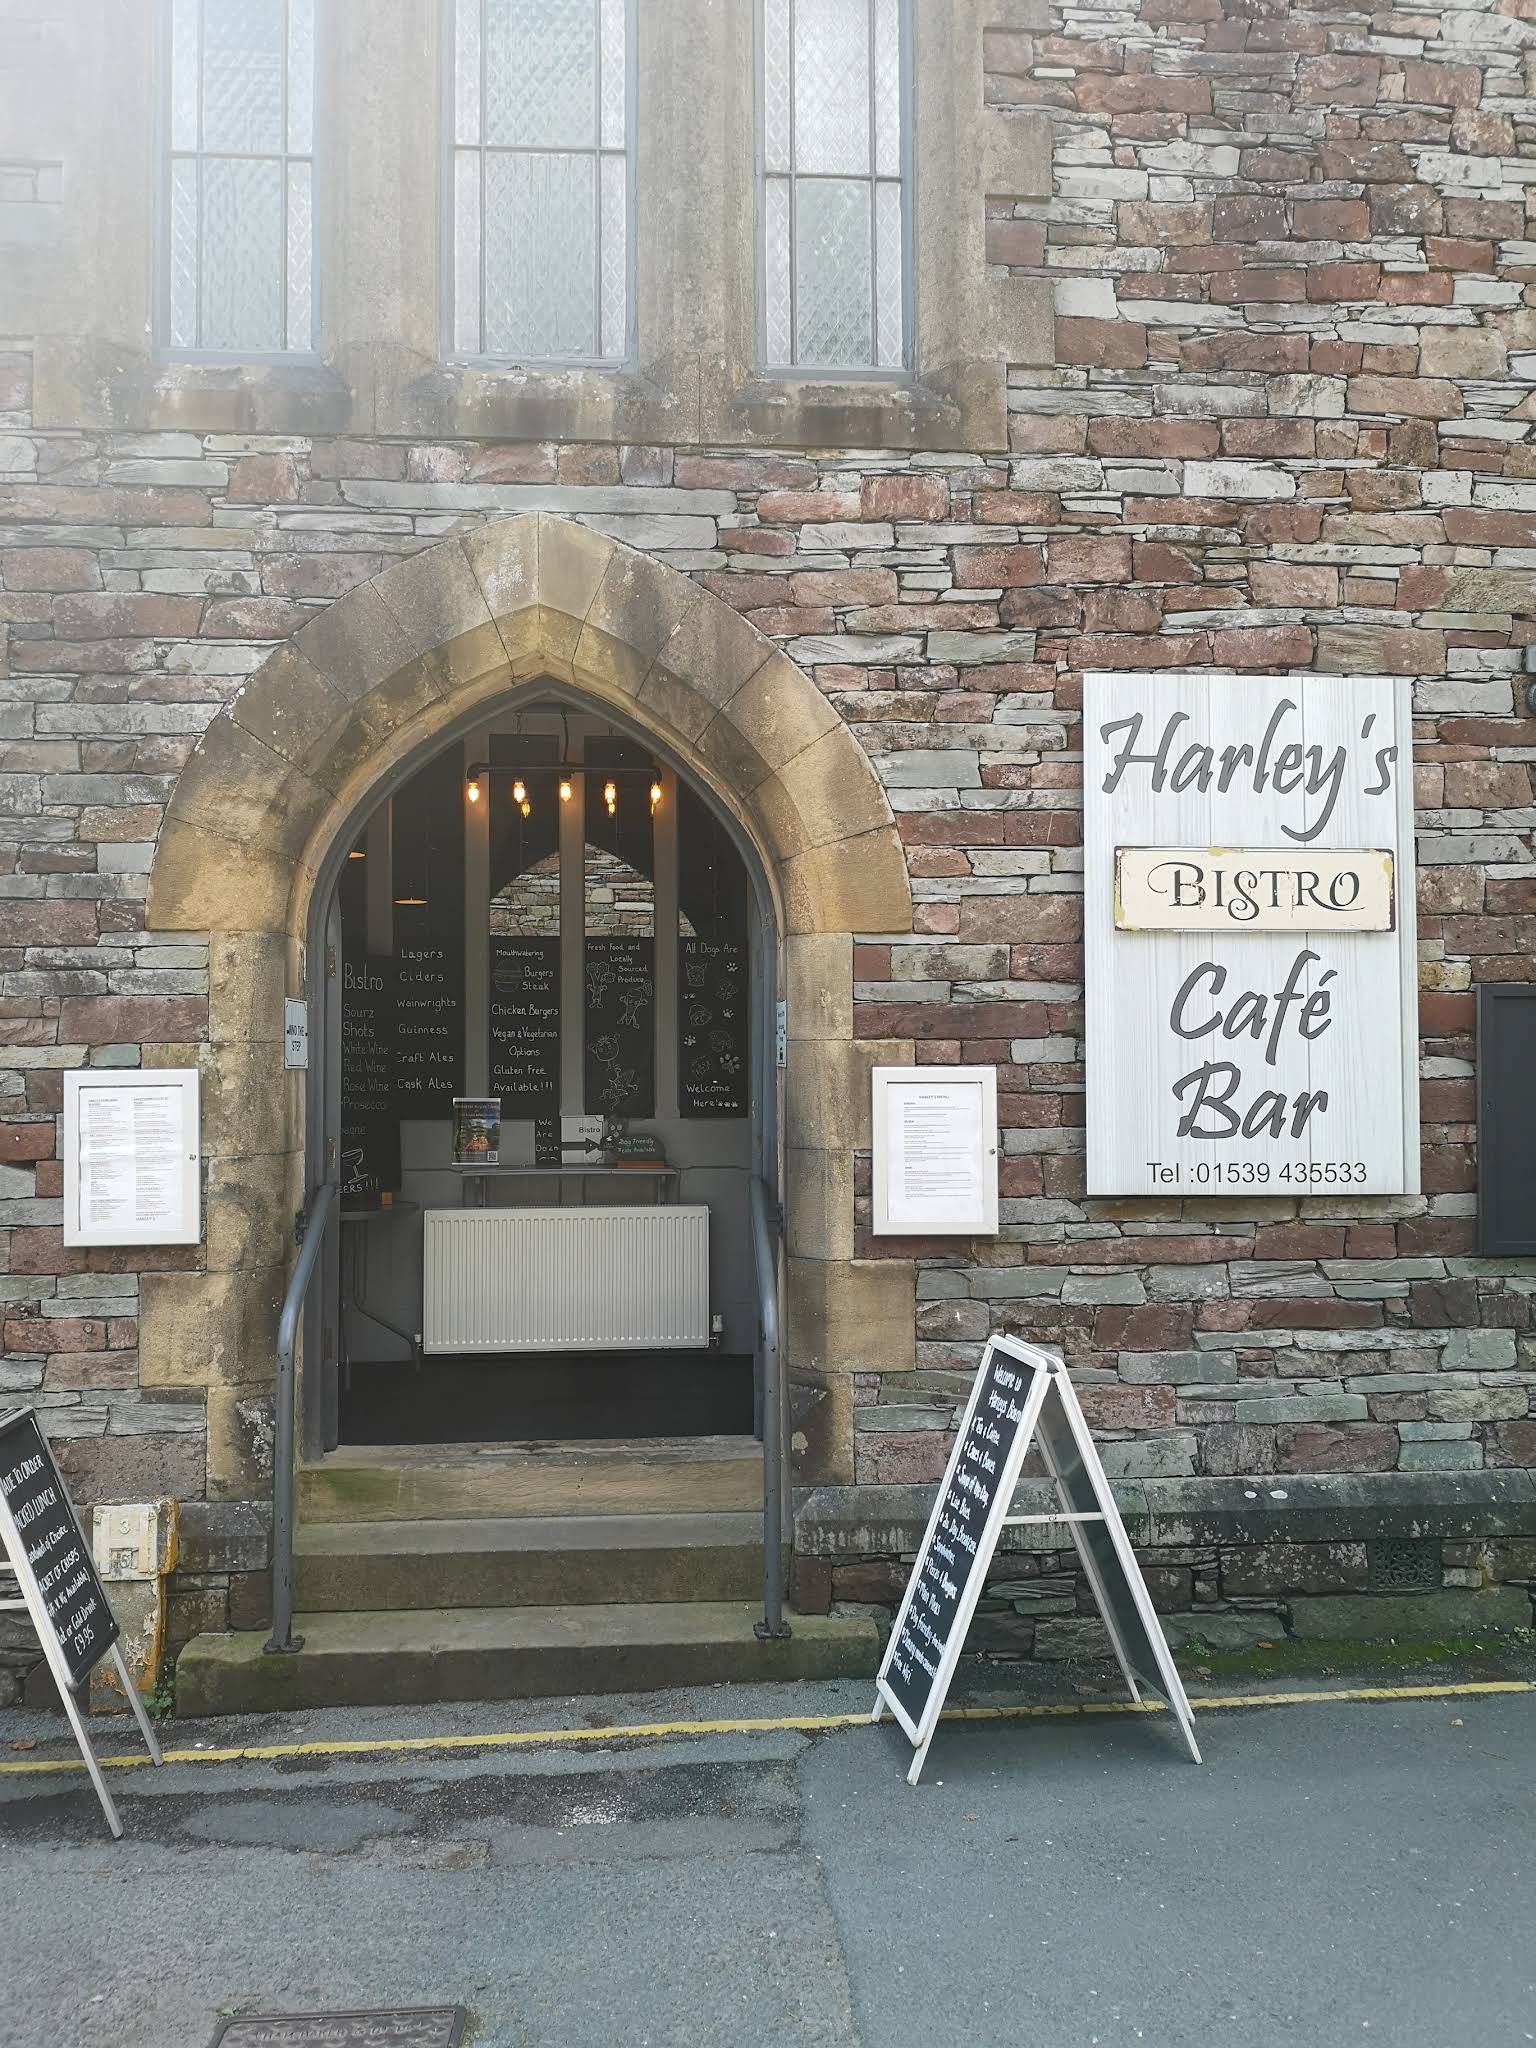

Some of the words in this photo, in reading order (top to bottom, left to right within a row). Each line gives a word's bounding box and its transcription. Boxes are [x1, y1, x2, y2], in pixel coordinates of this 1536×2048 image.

[1100, 699, 1399, 842] Harley's
[1148, 862, 1366, 921] BISTRO
[587, 943, 605, 951] Fresh
[610, 943, 624, 951] Food
[686, 944, 696, 953] All
[700, 944, 719, 956] Dogs
[724, 945, 738, 953] Are
[401, 949, 443, 961] Lagers
[497, 949, 543, 960] Mouthwatering
[610, 956, 633, 964] Locally
[344, 963, 384, 991] Bistro
[400, 972, 443, 983] Ciders
[524, 966, 553, 980] Burgers
[522, 981, 550, 991] Steak
[344, 1004, 374, 1019] Sourz
[491, 1004, 526, 1015] Chicken
[529, 1004, 558, 1019] Burgers
[1169, 950, 1338, 1066] Café
[343, 1022, 374, 1037] Shots
[398, 1024, 448, 1035] Guinness
[492, 1027, 515, 1041] Vegan
[368, 1042, 388, 1054] Wine
[509, 1046, 540, 1058] Options
[430, 1053, 454, 1062] Ales
[344, 1058, 362, 1072] Red
[365, 1060, 387, 1072] Wine
[494, 1065, 523, 1075] Gluten
[528, 1066, 547, 1075] Free
[368, 1078, 389, 1091] Wine
[397, 1078, 422, 1090] Cask
[428, 1078, 453, 1089] Ales
[686, 1084, 731, 1093] Welcome
[1172, 1060, 1328, 1139] Bar
[1146, 1162, 1180, 1184] Tel
[1278, 1162, 1368, 1184] 435533
[20, 1455, 43, 1479] ORDER
[32, 1487, 56, 1515] LUNCH
[120, 1520, 130, 1535] 3
[28, 1539, 46, 1564] andwich
[38, 1571, 54, 1594] ACKET
